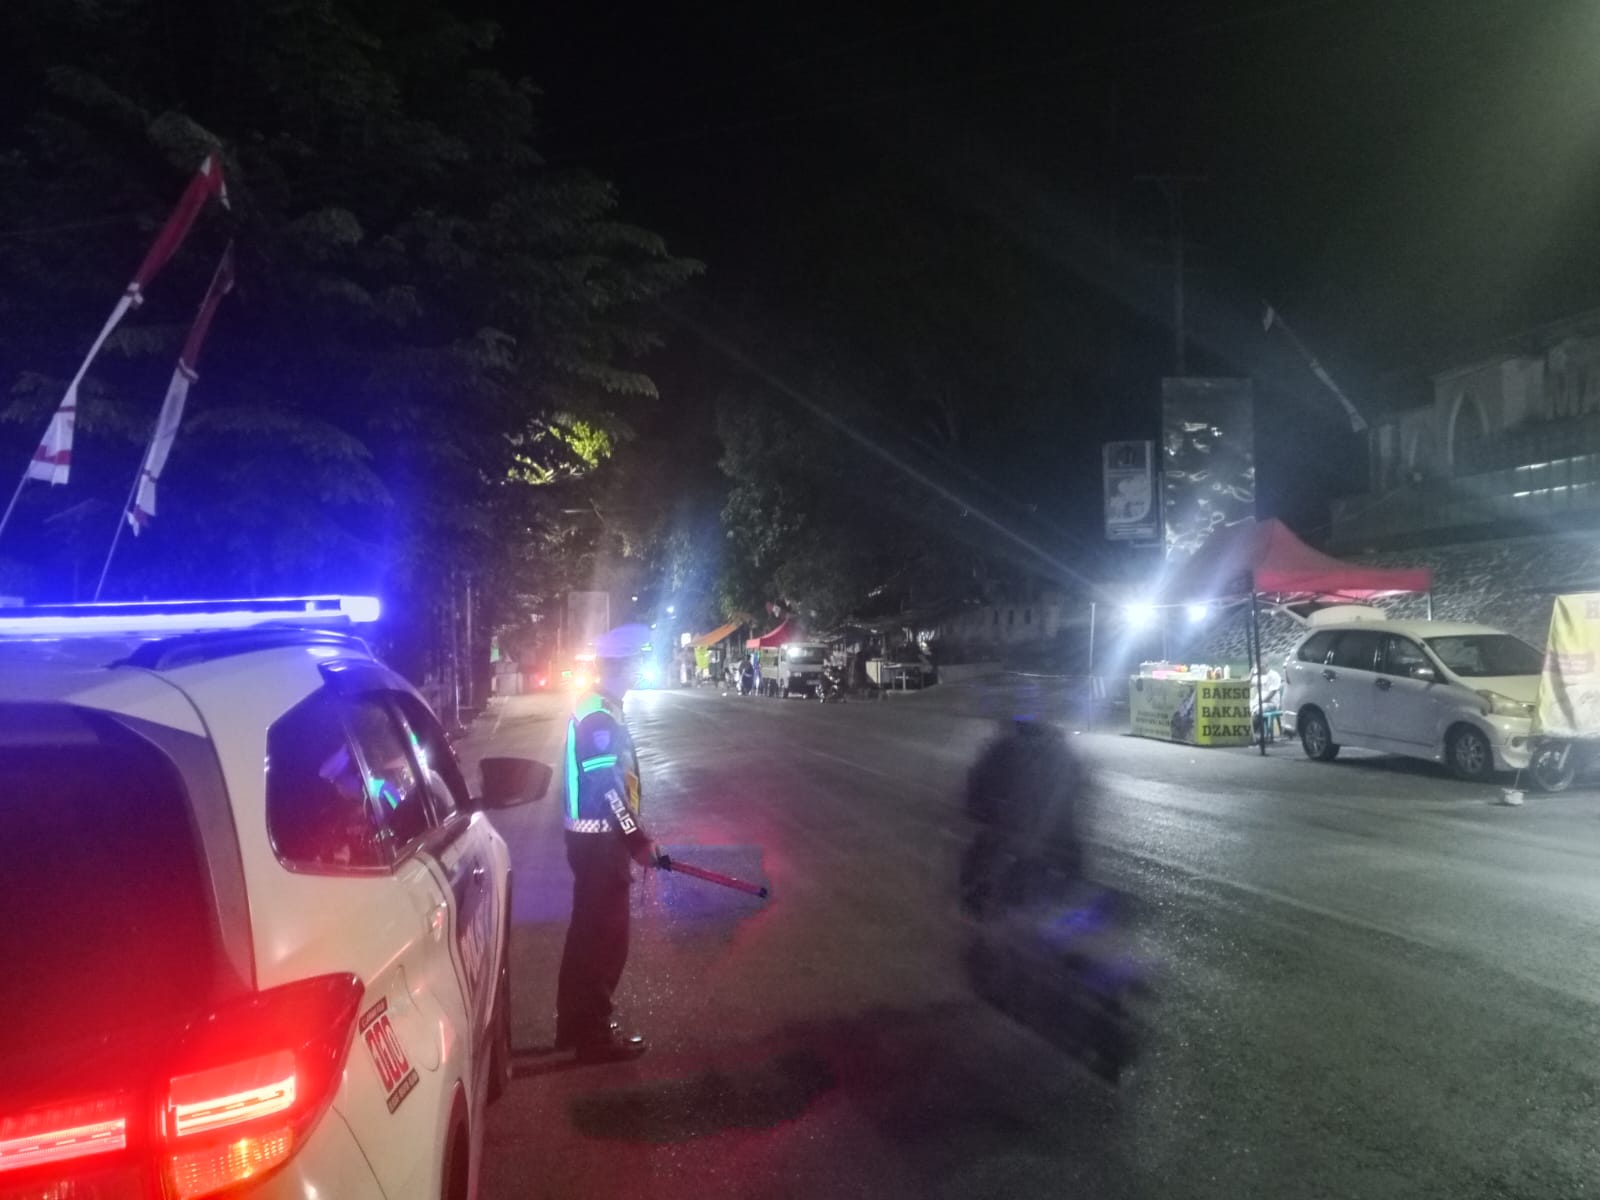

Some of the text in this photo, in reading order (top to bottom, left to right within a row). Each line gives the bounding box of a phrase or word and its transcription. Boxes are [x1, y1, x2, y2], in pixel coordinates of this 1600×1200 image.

[1202, 687, 1250, 699] BAKSO
[1202, 706, 1251, 718] BAKAR
[1202, 725, 1251, 737] DZAKY
[604, 788, 637, 835] POLISI
